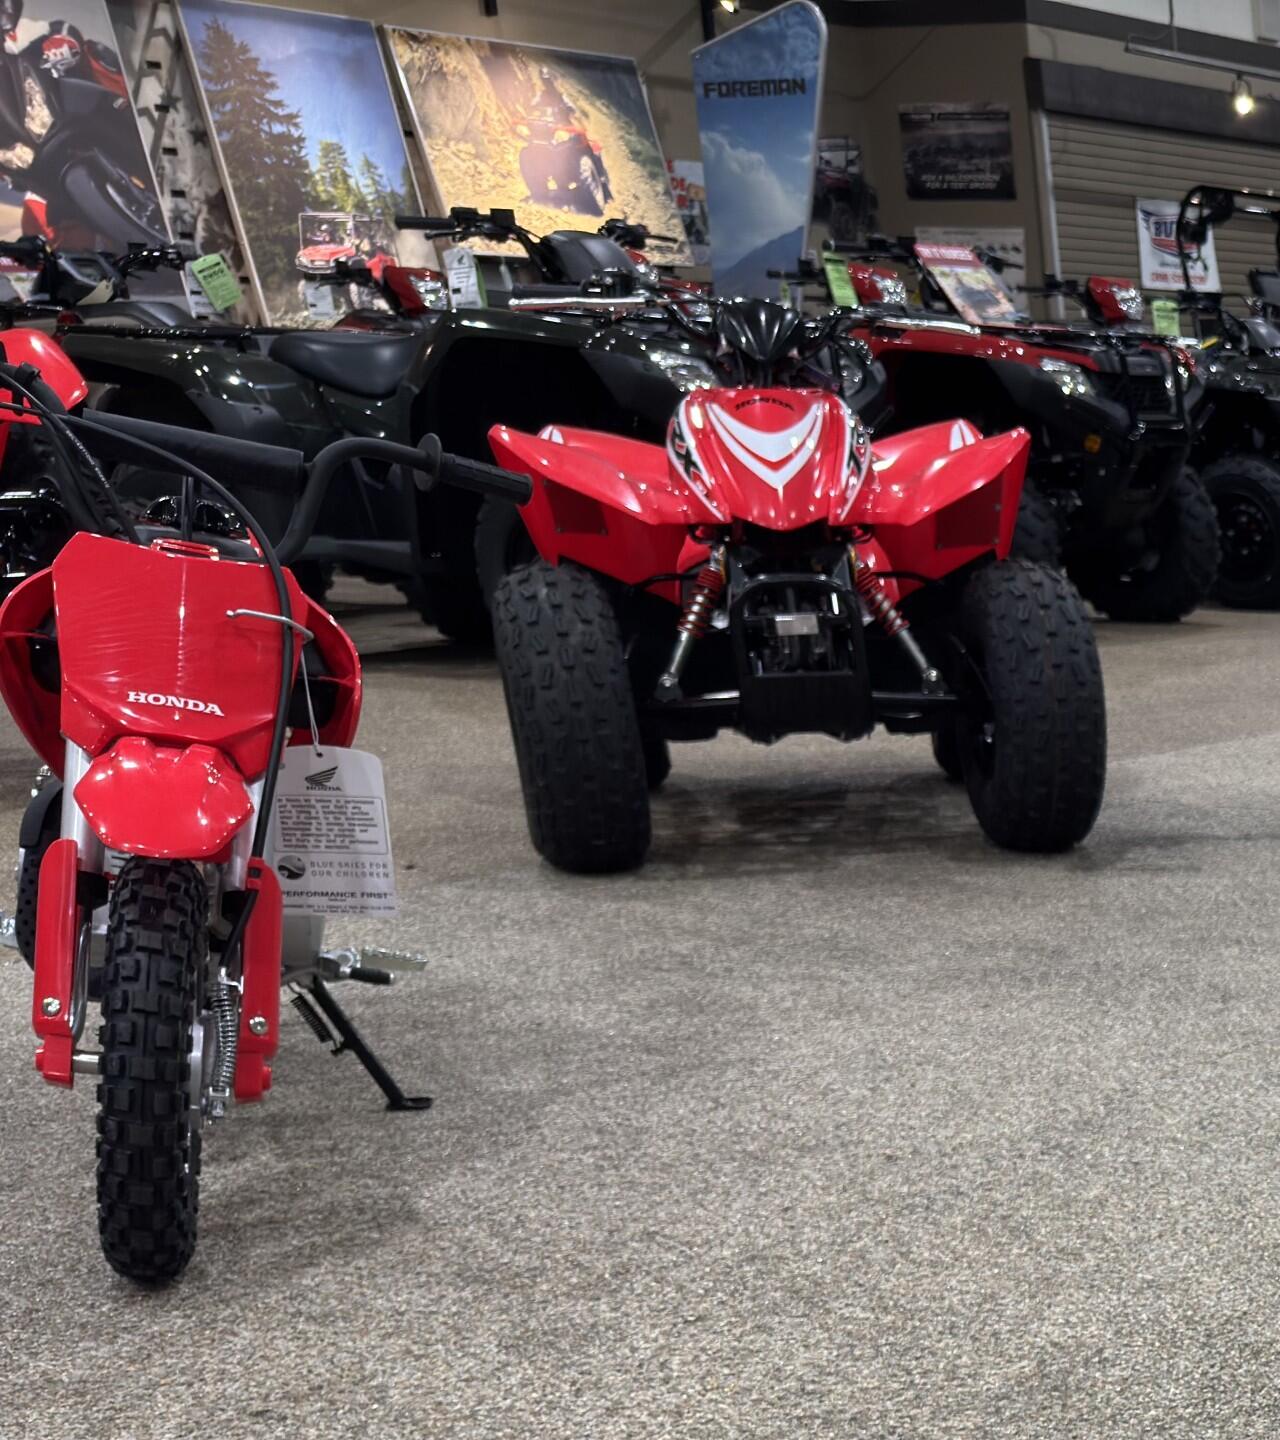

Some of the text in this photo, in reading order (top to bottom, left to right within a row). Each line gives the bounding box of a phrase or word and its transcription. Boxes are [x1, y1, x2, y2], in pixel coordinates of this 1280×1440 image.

[703, 78, 806, 98] FOREMAN
[735, 396, 795, 411] HONDA
[127, 690, 225, 717] HONDA
[310, 860, 389, 870] BLUE SKIES FOR
[311, 869, 390, 879] OUR CHILDREN
